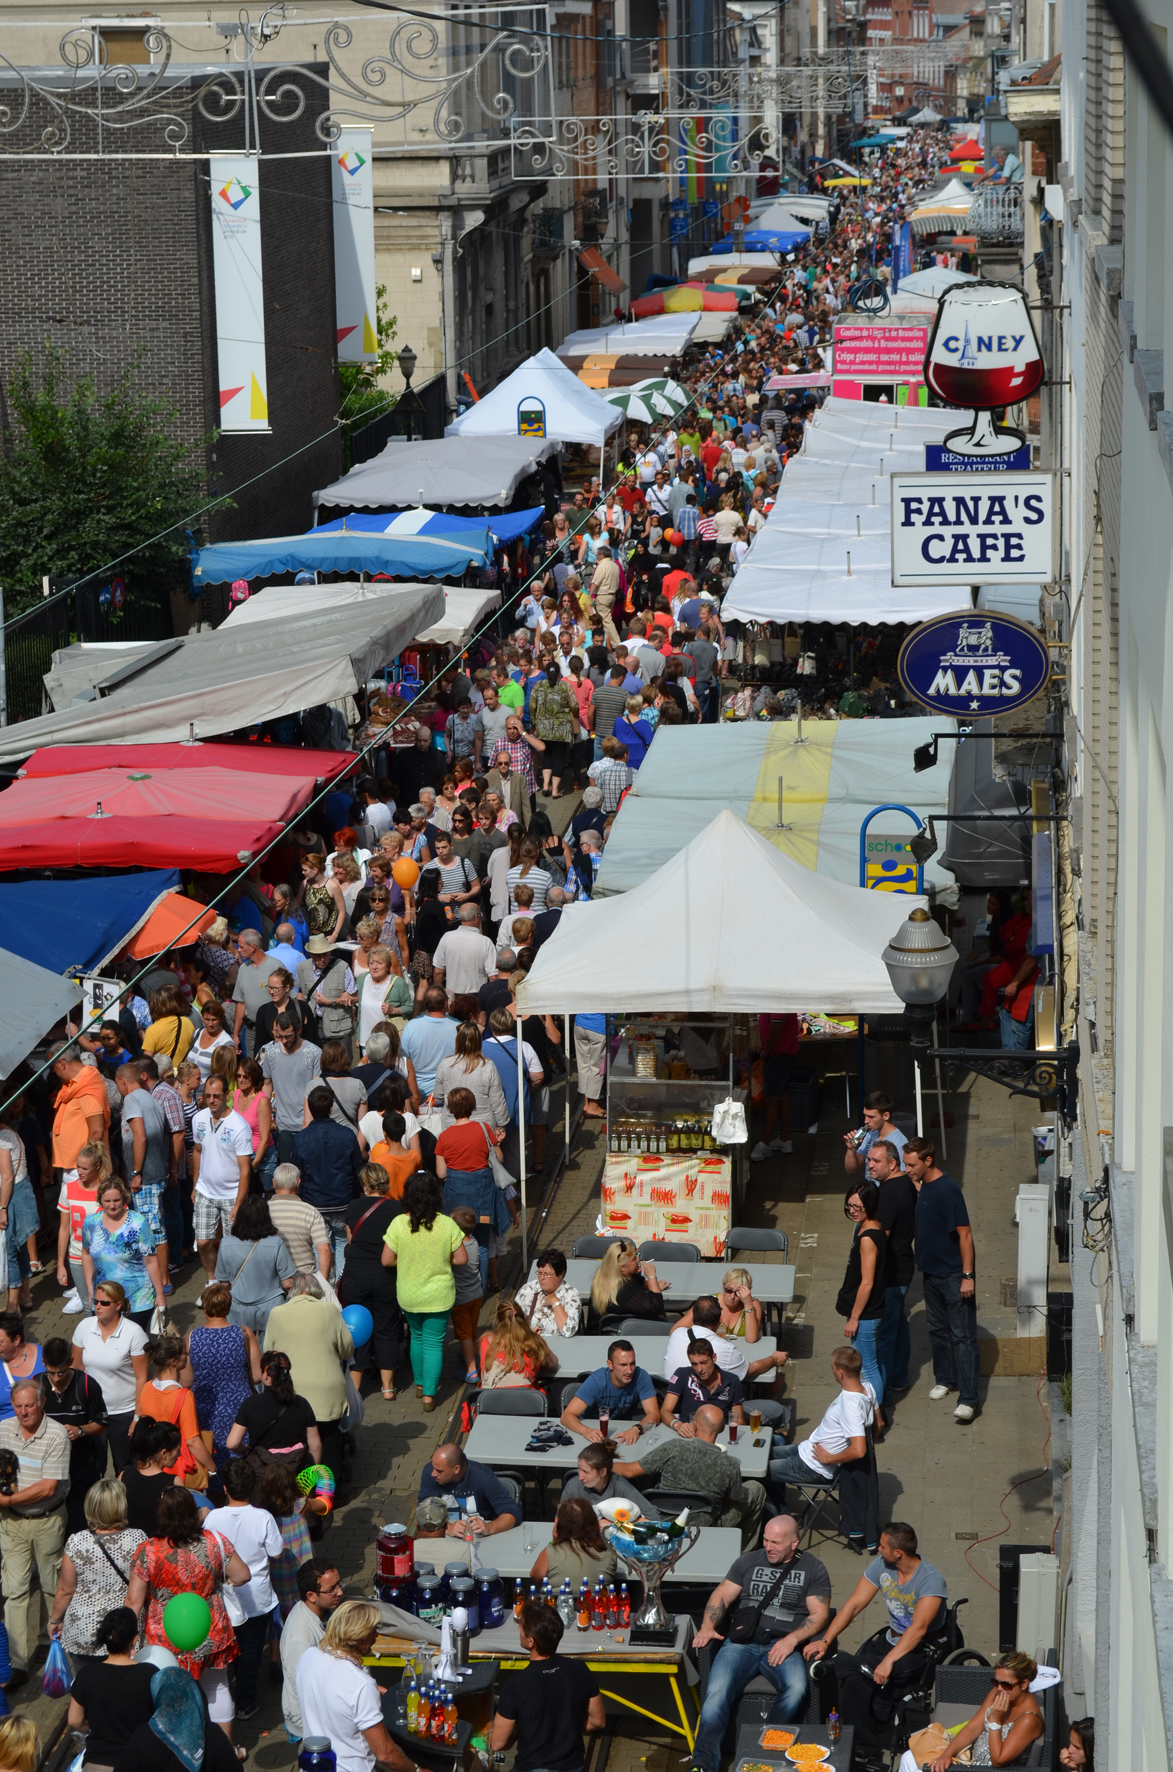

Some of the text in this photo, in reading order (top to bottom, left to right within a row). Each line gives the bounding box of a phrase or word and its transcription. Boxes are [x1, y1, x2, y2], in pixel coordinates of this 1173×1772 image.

[840, 328, 861, 337] Gaufres
[862, 328, 869, 337] de
[890, 328, 897, 337] de
[898, 328, 923, 337] Bruxelles
[874, 339, 880, 348] &
[836, 351, 855, 363] Crêpe
[880, 352, 901, 361] sucrée
[901, 352, 908, 361] &
[901, 494, 1045, 527] FANA'S
[921, 532, 1026, 564] CAFE
[926, 668, 1022, 697] MAES
[868, 838, 913, 853] schoo
[754, 1567, 802, 1585] G-SAR
